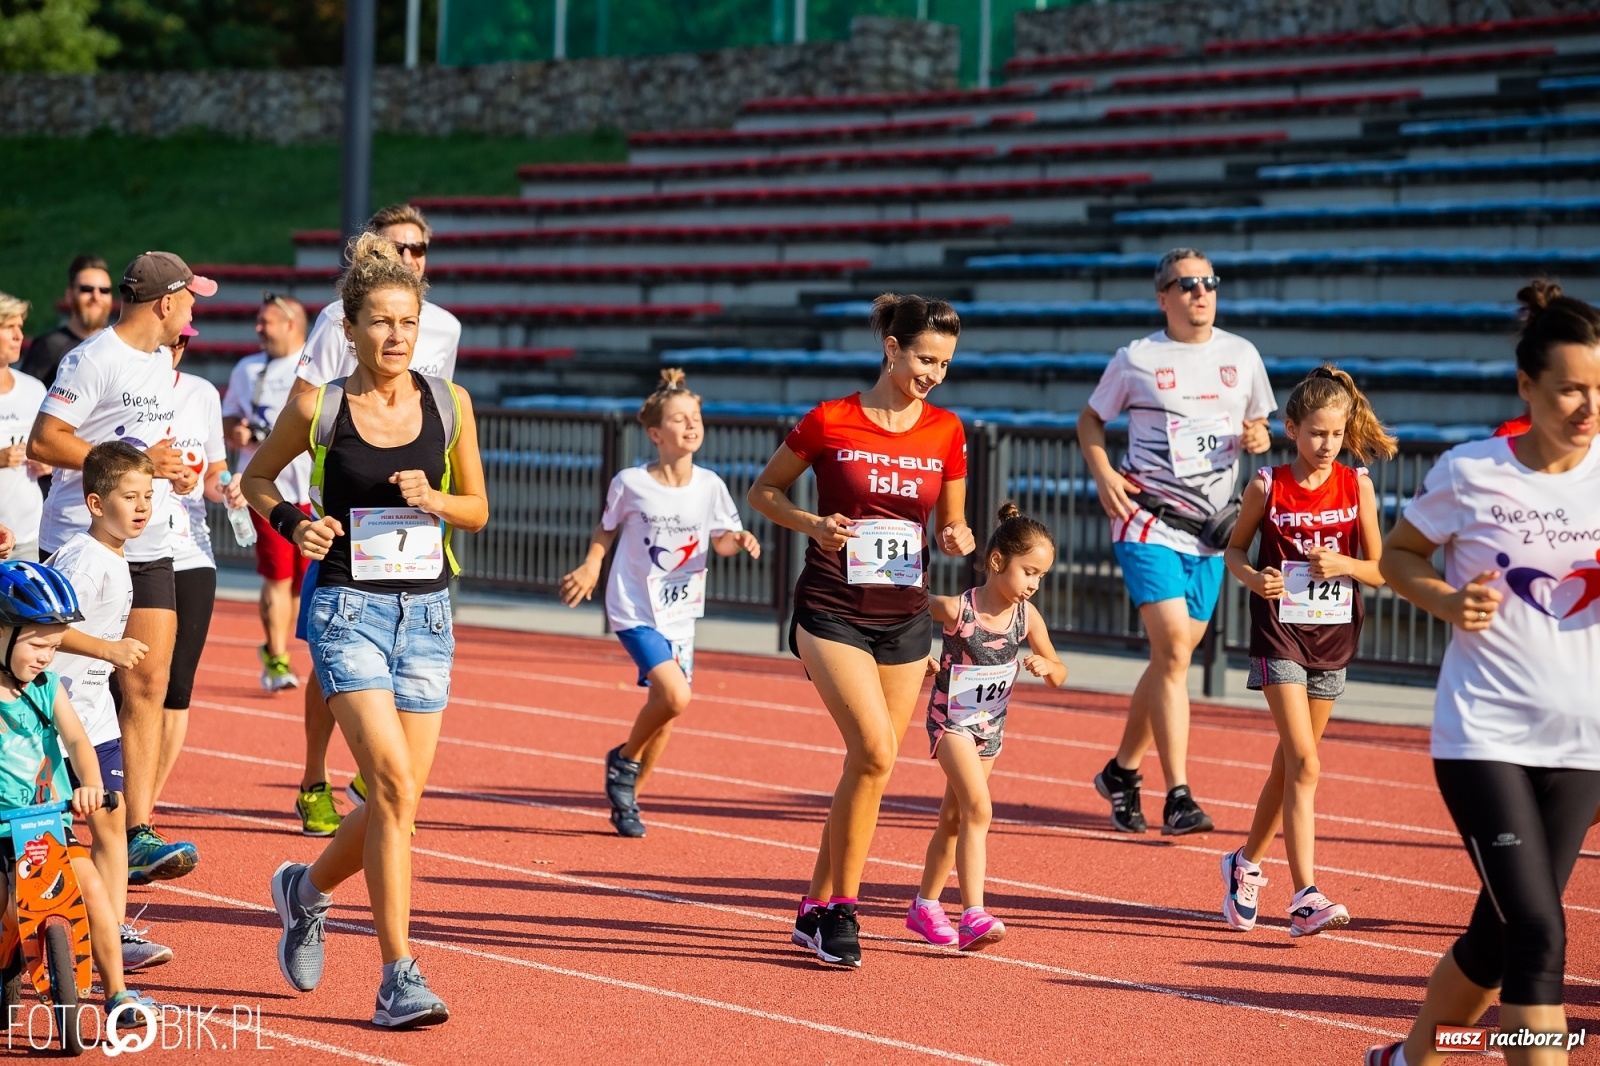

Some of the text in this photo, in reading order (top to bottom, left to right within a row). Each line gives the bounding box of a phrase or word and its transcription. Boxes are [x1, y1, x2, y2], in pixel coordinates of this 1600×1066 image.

[51, 386, 80, 404] nowiny
[1197, 434, 1217, 452] 30
[837, 449, 943, 472] DAR-BUD
[1491, 505, 1570, 536] Biegnę
[396, 529, 408, 552] 7
[1519, 529, 1534, 545] z
[874, 538, 909, 561] 131
[1307, 580, 1341, 601] 124
[975, 680, 1007, 704] 129
